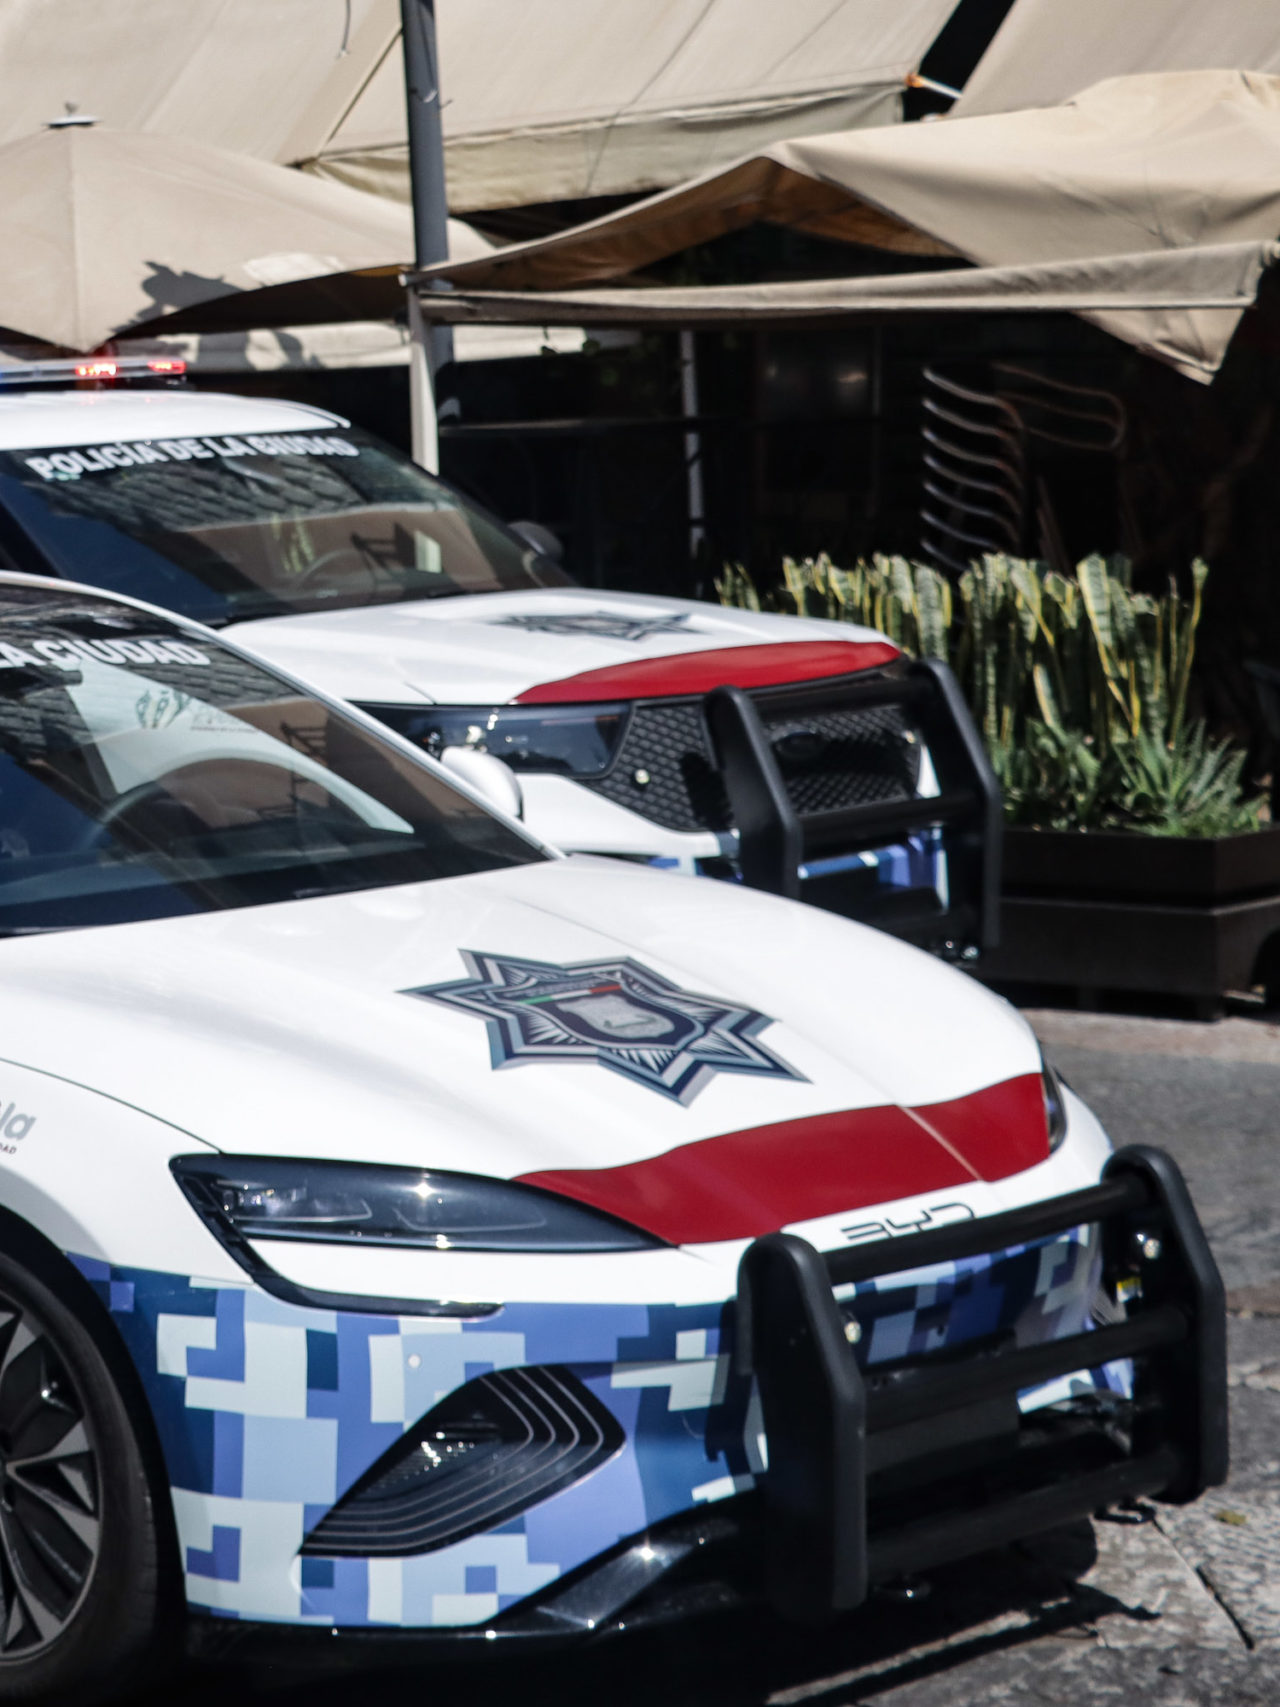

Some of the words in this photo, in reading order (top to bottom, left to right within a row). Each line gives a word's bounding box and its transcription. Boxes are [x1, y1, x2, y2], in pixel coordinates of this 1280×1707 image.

[158, 438, 215, 461] DE
[201, 436, 259, 458] LA
[32, 638, 211, 668] CIUDAD
